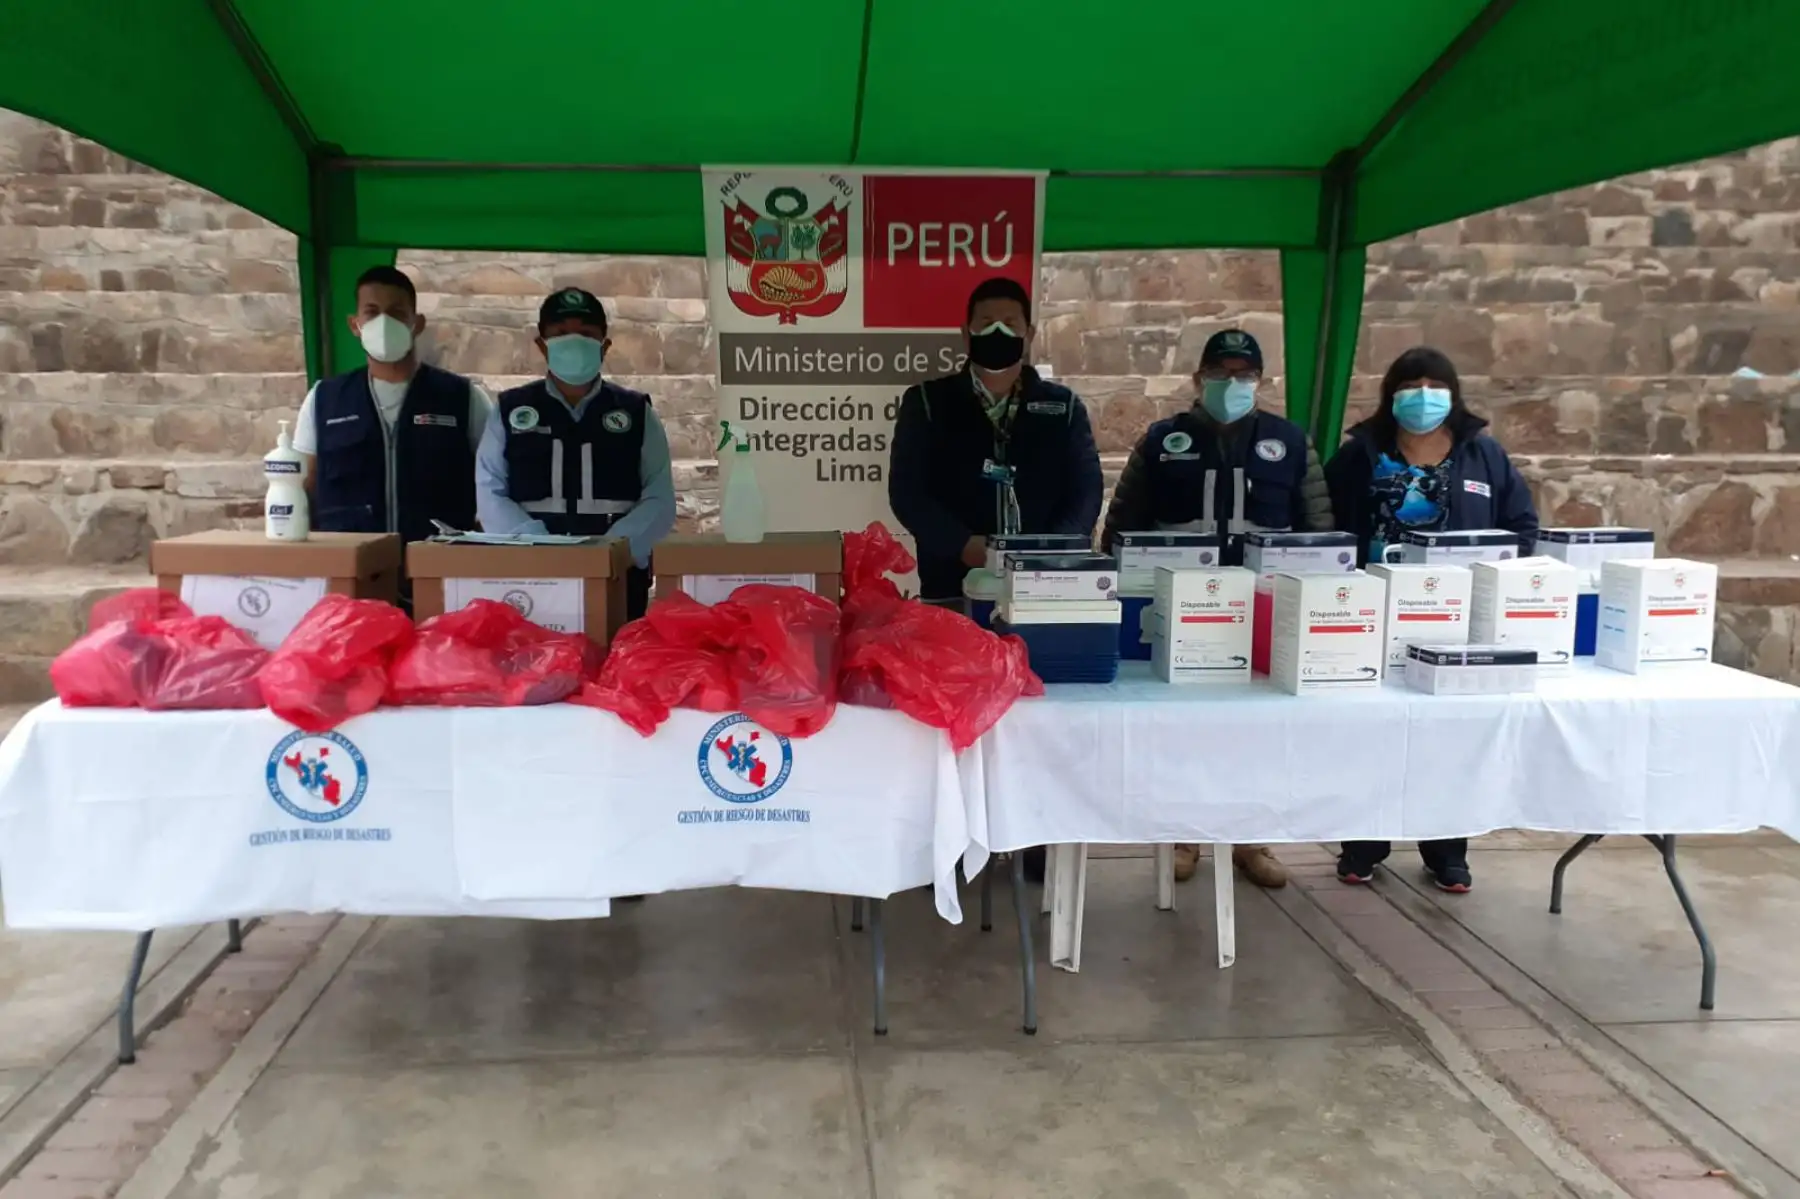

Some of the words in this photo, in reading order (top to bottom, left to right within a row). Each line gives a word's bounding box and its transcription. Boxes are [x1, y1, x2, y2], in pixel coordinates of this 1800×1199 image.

[887, 211, 1013, 267] PERÚ
[735, 346, 883, 373] Ministerio
[894, 346, 929, 373] de
[938, 347, 969, 373] Sa
[739, 396, 873, 421] Dirección
[884, 396, 900, 421] d
[747, 427, 886, 457] ntegradas
[816, 458, 882, 482] Lima
[1180, 601, 1220, 609] Disposable
